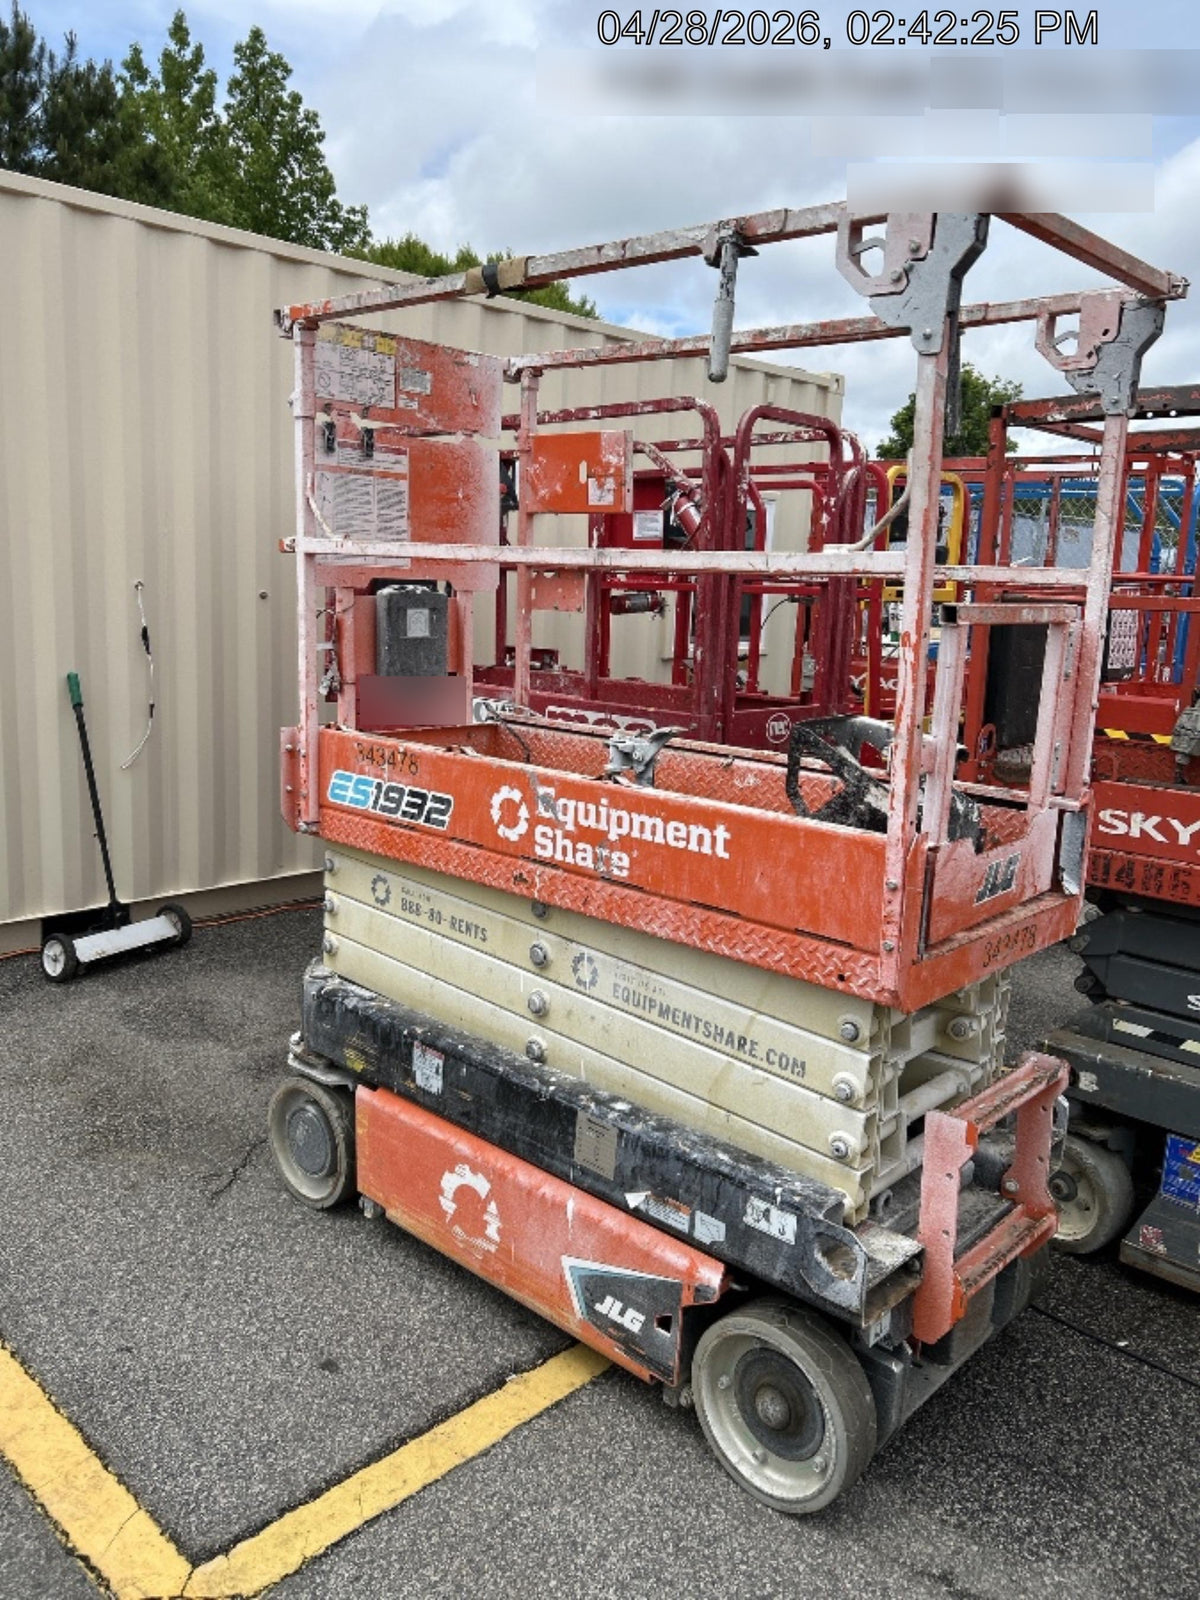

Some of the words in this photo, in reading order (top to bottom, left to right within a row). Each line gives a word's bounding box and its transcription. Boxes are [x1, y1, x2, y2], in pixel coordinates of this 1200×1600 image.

[354, 742, 419, 775] 343478
[327, 770, 454, 830] ES1932
[536, 786, 731, 859] Equipment
[534, 824, 631, 877] Share
[613, 983, 806, 1079] EQUIPMENTSHARE.COM
[594, 1295, 646, 1334] JLG
